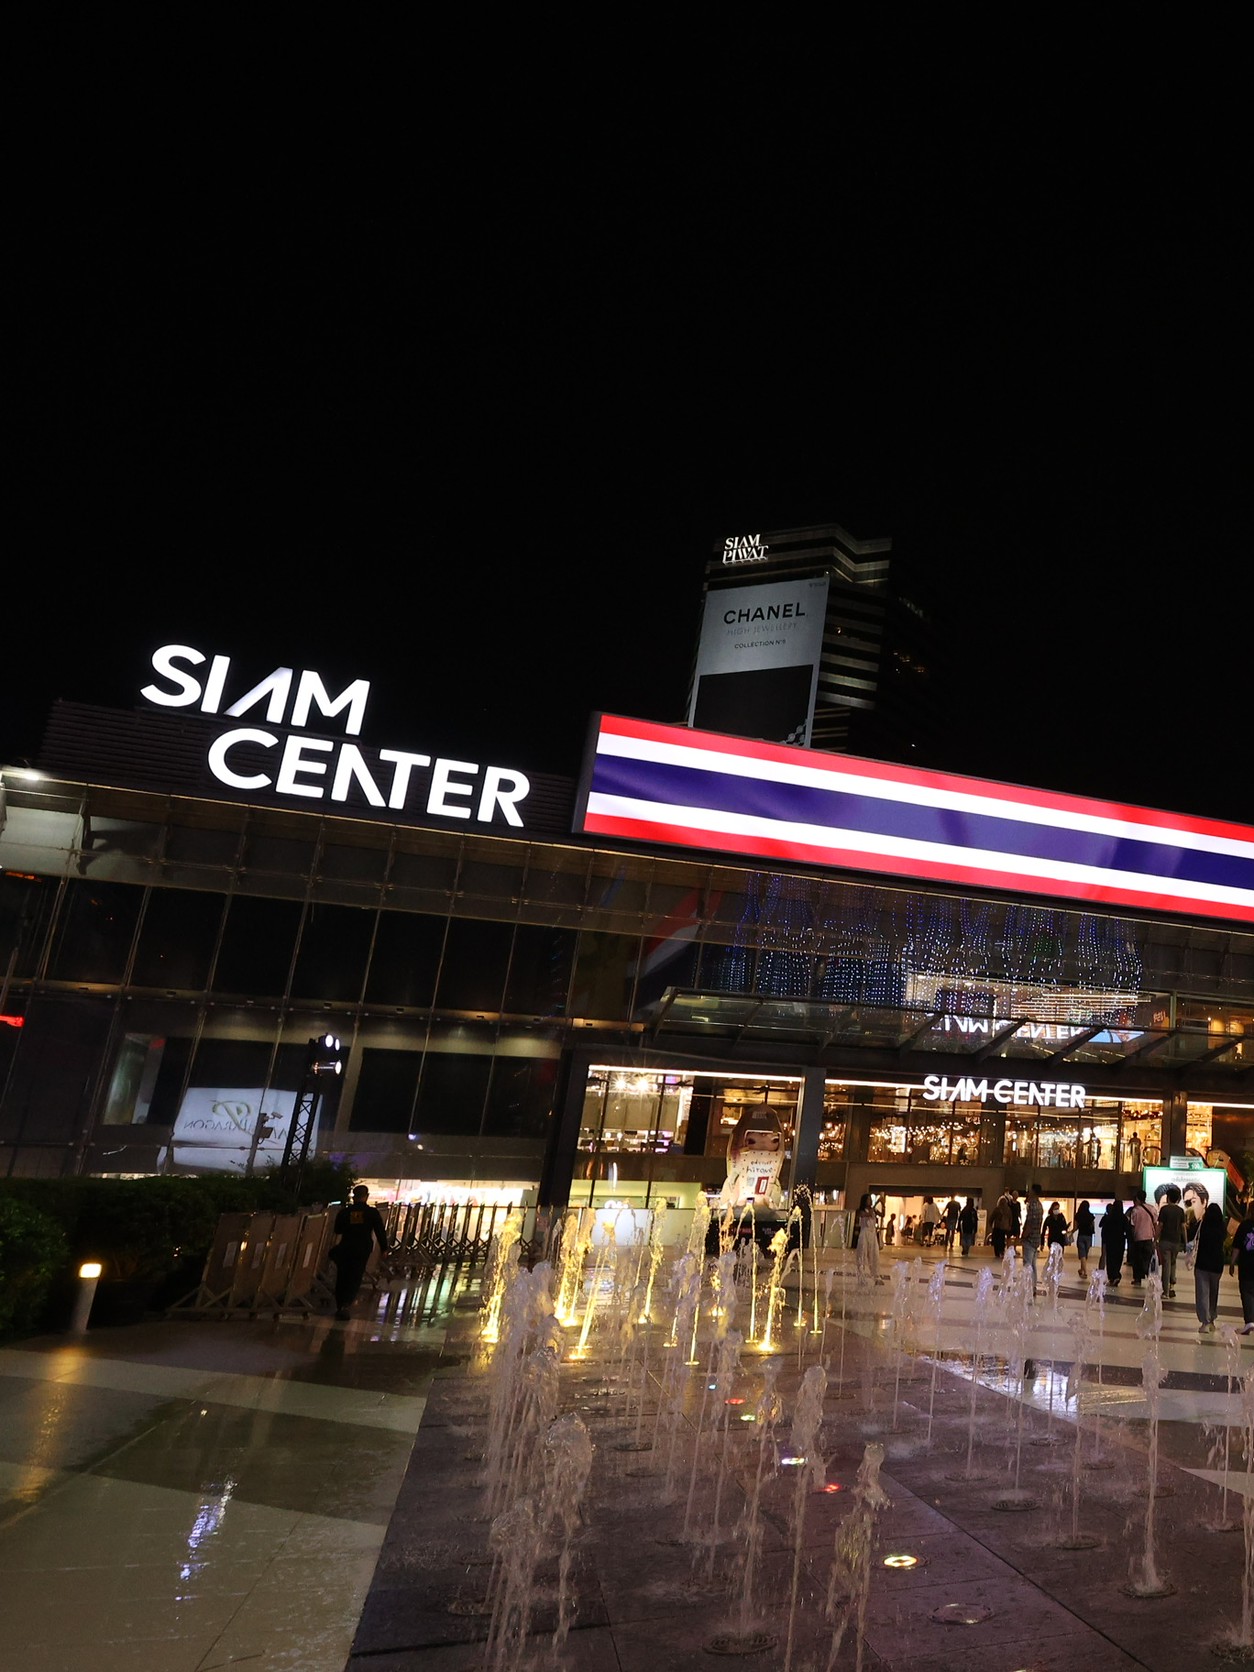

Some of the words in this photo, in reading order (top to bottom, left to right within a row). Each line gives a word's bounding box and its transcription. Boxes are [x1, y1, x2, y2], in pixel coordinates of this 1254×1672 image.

[724, 533, 761, 550] SIAM
[722, 545, 769, 564] PIWAT
[723, 602, 806, 625] CHANEL
[734, 639, 775, 649] COLLECTION
[141, 645, 370, 735] SIAM
[208, 728, 530, 827] CENTER
[922, 1075, 988, 1102] SIAM
[993, 1079, 1086, 1109] CENTER
